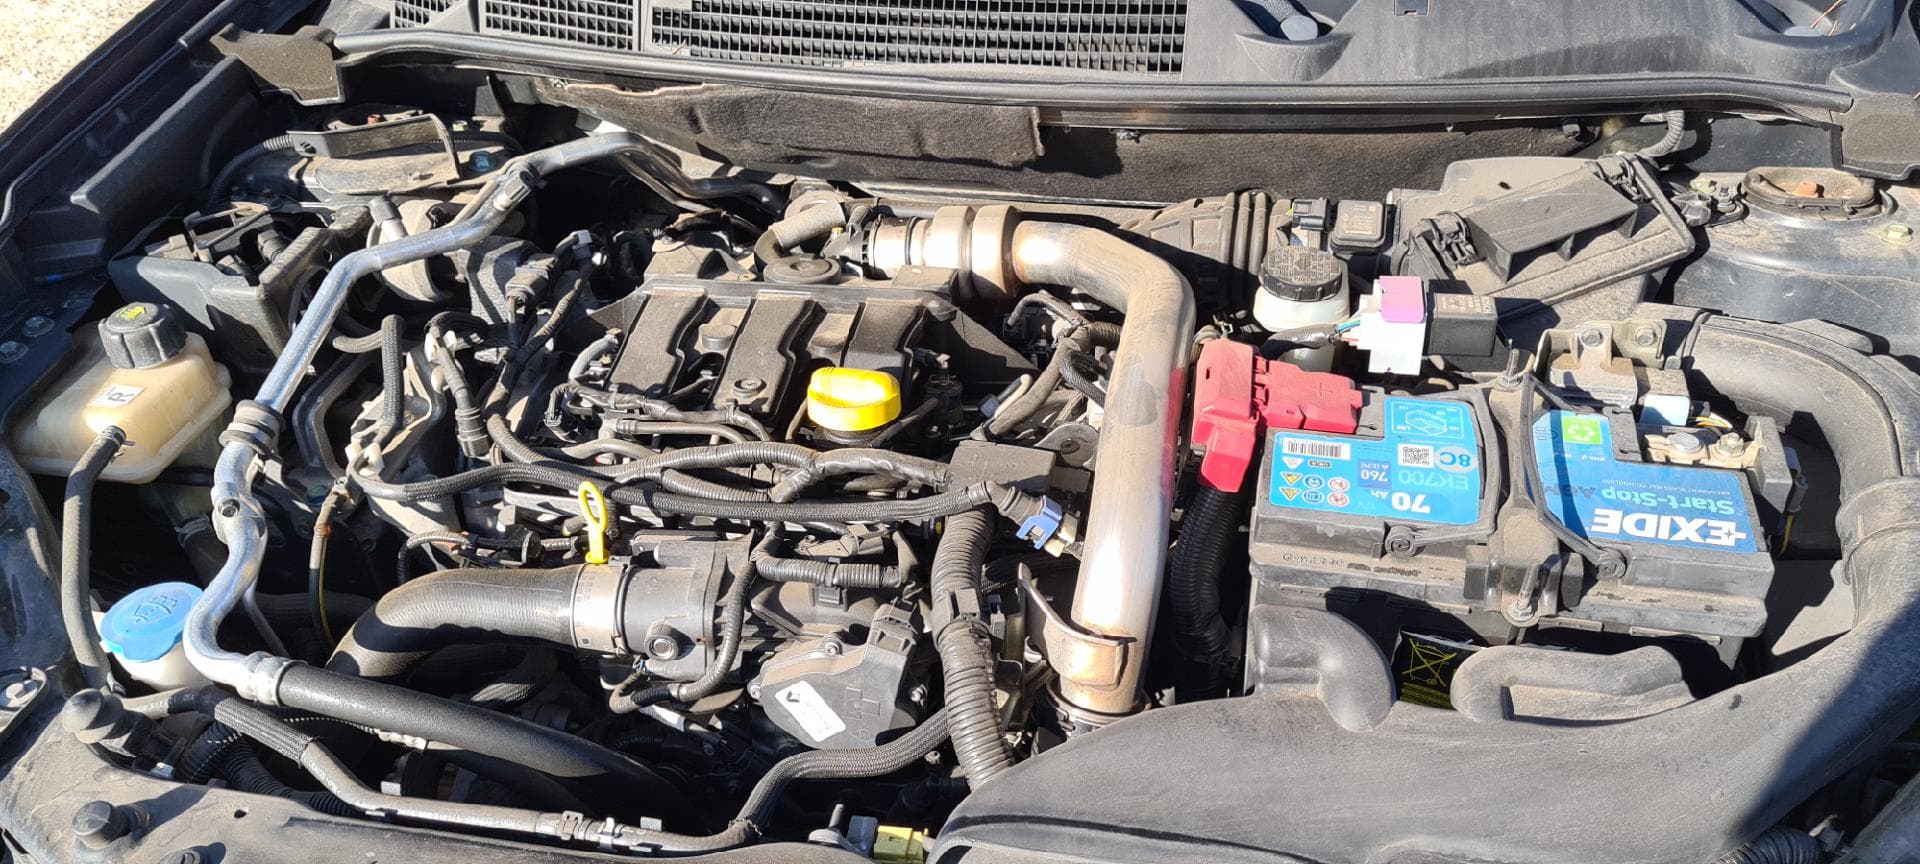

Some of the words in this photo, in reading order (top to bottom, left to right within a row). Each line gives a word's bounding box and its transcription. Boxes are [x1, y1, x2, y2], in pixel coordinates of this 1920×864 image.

[1439, 451, 1472, 467] 8C
[1360, 469, 1389, 482] 760
[1398, 470, 1469, 490] EK700
[1370, 489, 1389, 499] Ah
[1391, 491, 1431, 514] 70
[1601, 486, 1735, 515] Start-Stop
[1590, 508, 1747, 547] EXIDE
